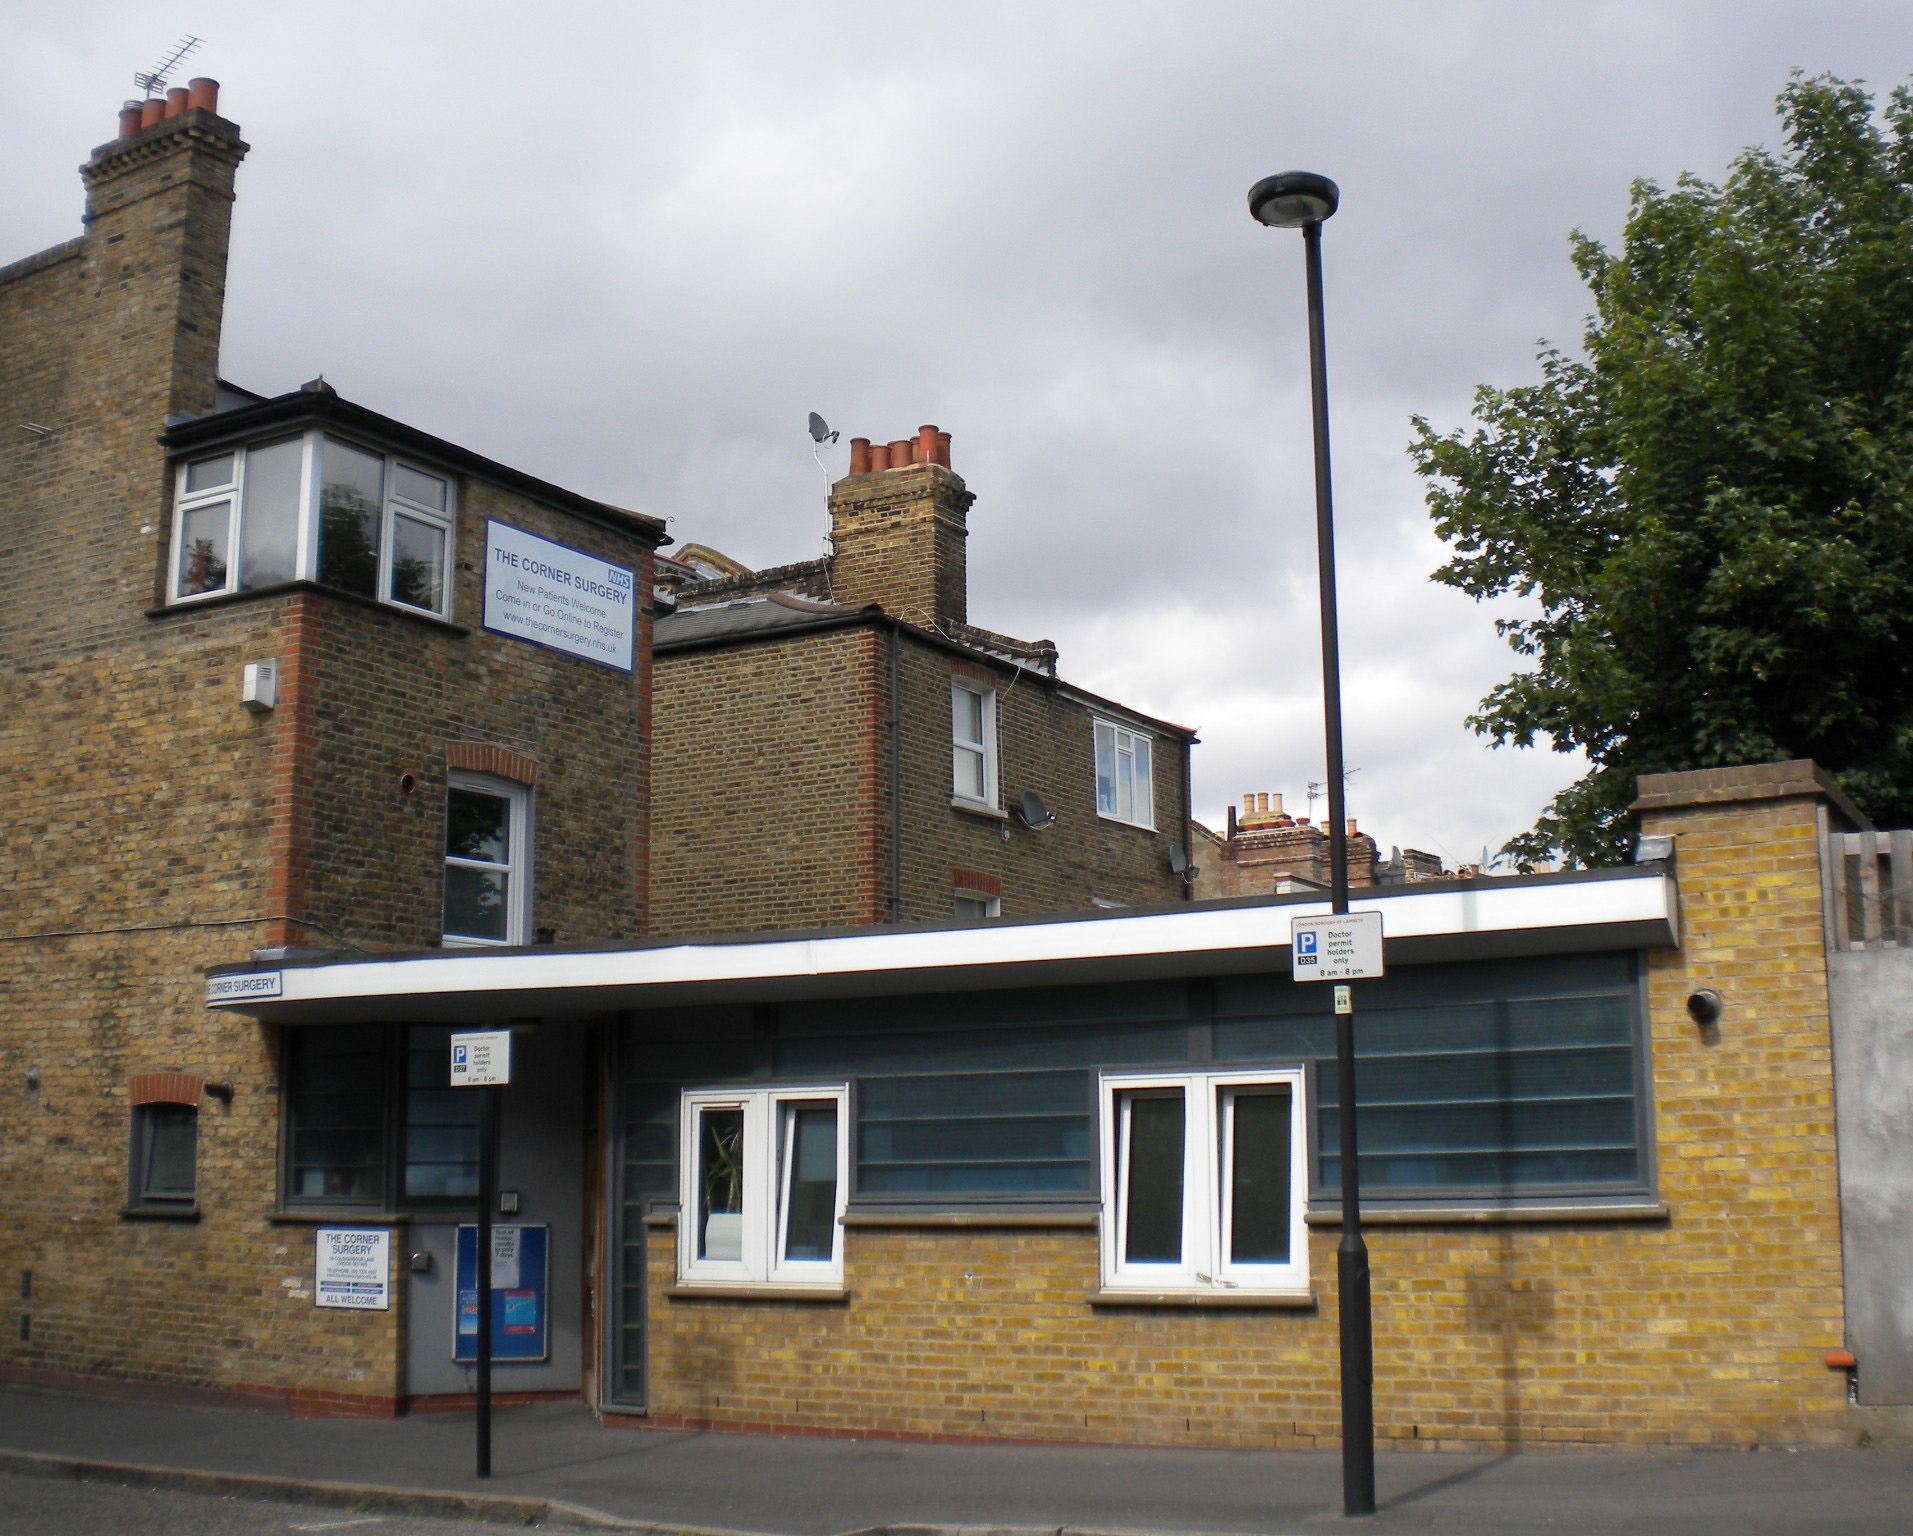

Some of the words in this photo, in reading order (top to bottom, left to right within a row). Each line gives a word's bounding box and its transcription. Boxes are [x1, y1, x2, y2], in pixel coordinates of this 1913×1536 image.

[494, 547, 519, 568] THE
[521, 557, 571, 587] CORNER
[574, 576, 627, 605] SURGERY
[609, 570, 631, 589] NHS
[517, 580, 536, 595] New
[537, 586, 570, 607] Patients
[571, 597, 607, 619] Welcome
[495, 589, 521, 606] Come
[523, 598, 531, 609] in
[533, 603, 541, 612] or
[543, 604, 555, 617] Go
[556, 609, 582, 627] Online
[584, 618, 592, 630] to
[593, 620, 624, 640] Register
[503, 611, 617, 655] www.thecornersurgery.nhs.uk
[1328, 931, 1352, 939] Doctor
[1301, 933, 1314, 953] P
[1328, 939, 1352, 948] permit
[1327, 948, 1355, 956] holders
[1300, 957, 1316, 965] D35
[1333, 956, 1349, 965] only
[1352, 968, 1364, 976] pm
[234, 978, 276, 992] SURGERY
[456, 1047, 465, 1063] P
[325, 1233, 342, 1244] THE
[344, 1233, 380, 1245] CORNER
[332, 1244, 372, 1255] SURGERY
[325, 1294, 340, 1304] ALL
[341, 1295, 377, 1305] WELCOME
